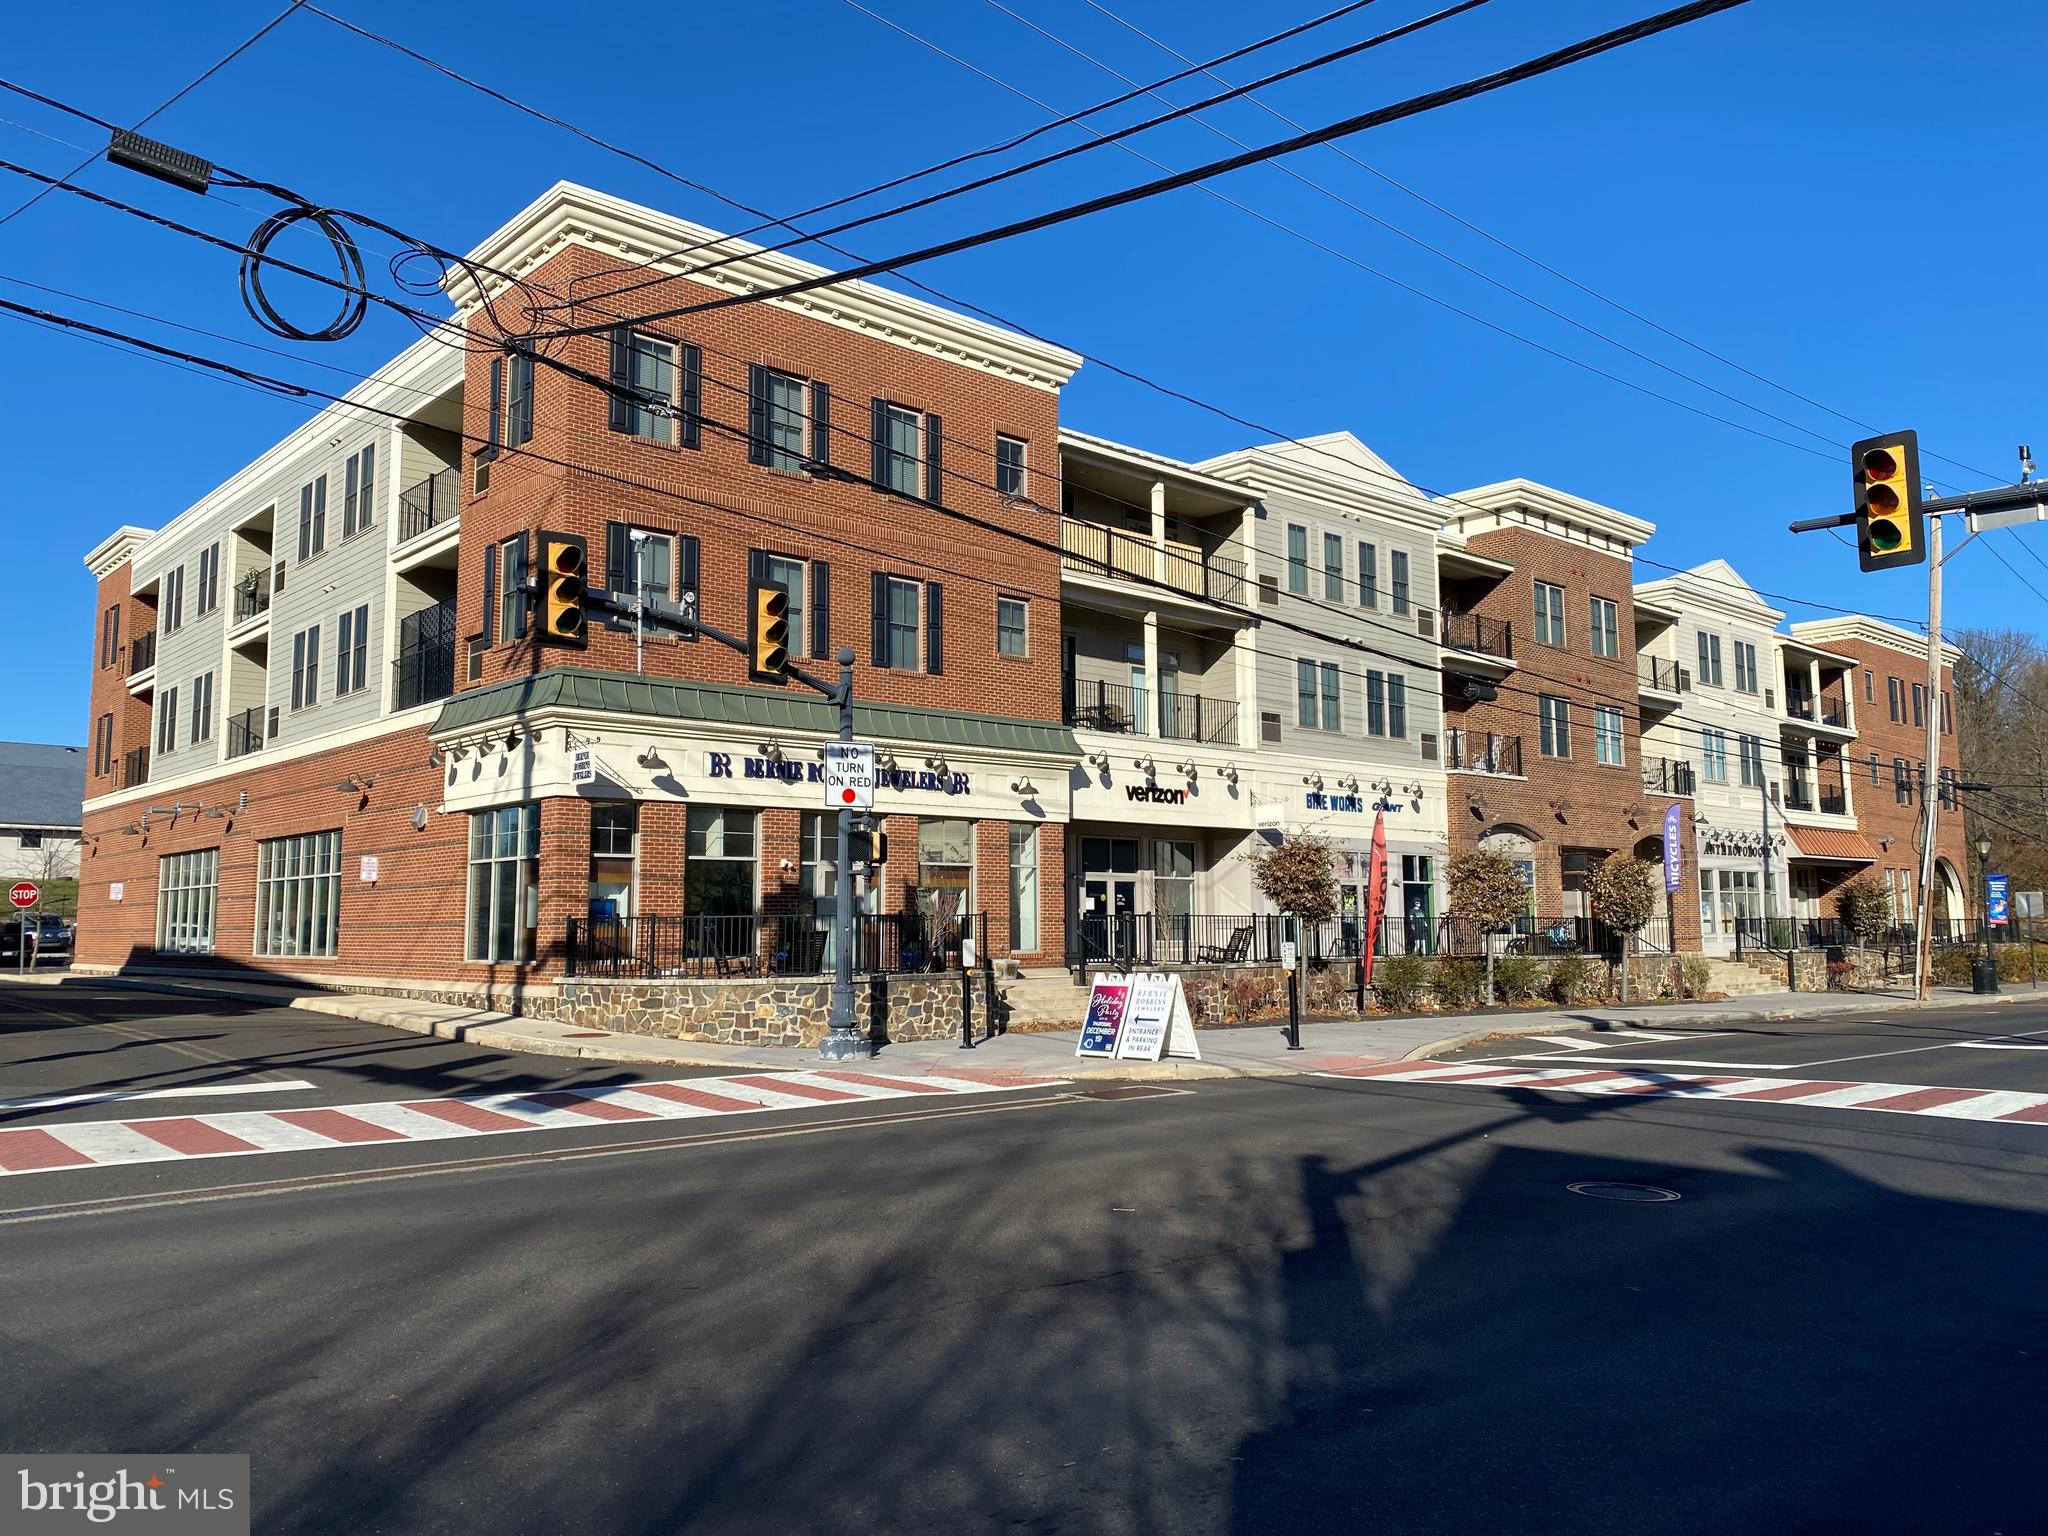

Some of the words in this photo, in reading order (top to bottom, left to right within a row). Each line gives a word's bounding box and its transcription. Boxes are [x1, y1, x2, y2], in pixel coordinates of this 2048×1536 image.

[840, 747, 859, 759] NO
[743, 757, 804, 781] BERNIE
[836, 762, 864, 773] TURN
[828, 776, 844, 786] ON
[849, 777, 871, 788] RED
[1125, 785, 1184, 805] verizon
[1306, 793, 1328, 811] BIKE
[1330, 795, 1363, 813] WORKS
[1258, 820, 1280, 828] verizon
[1668, 825, 1680, 885] BICYCLES
[11, 890, 37, 900] STOP
[1137, 990, 1169, 998] BERNIE
[1092, 993, 1124, 1010] Holiday
[1135, 998, 1166, 1006] ROBBINS
[1086, 1027, 1116, 1036] DECEMBER
[1128, 1028, 1160, 1036] ENTRANCE
[1132, 1036, 1158, 1044] PARKING
